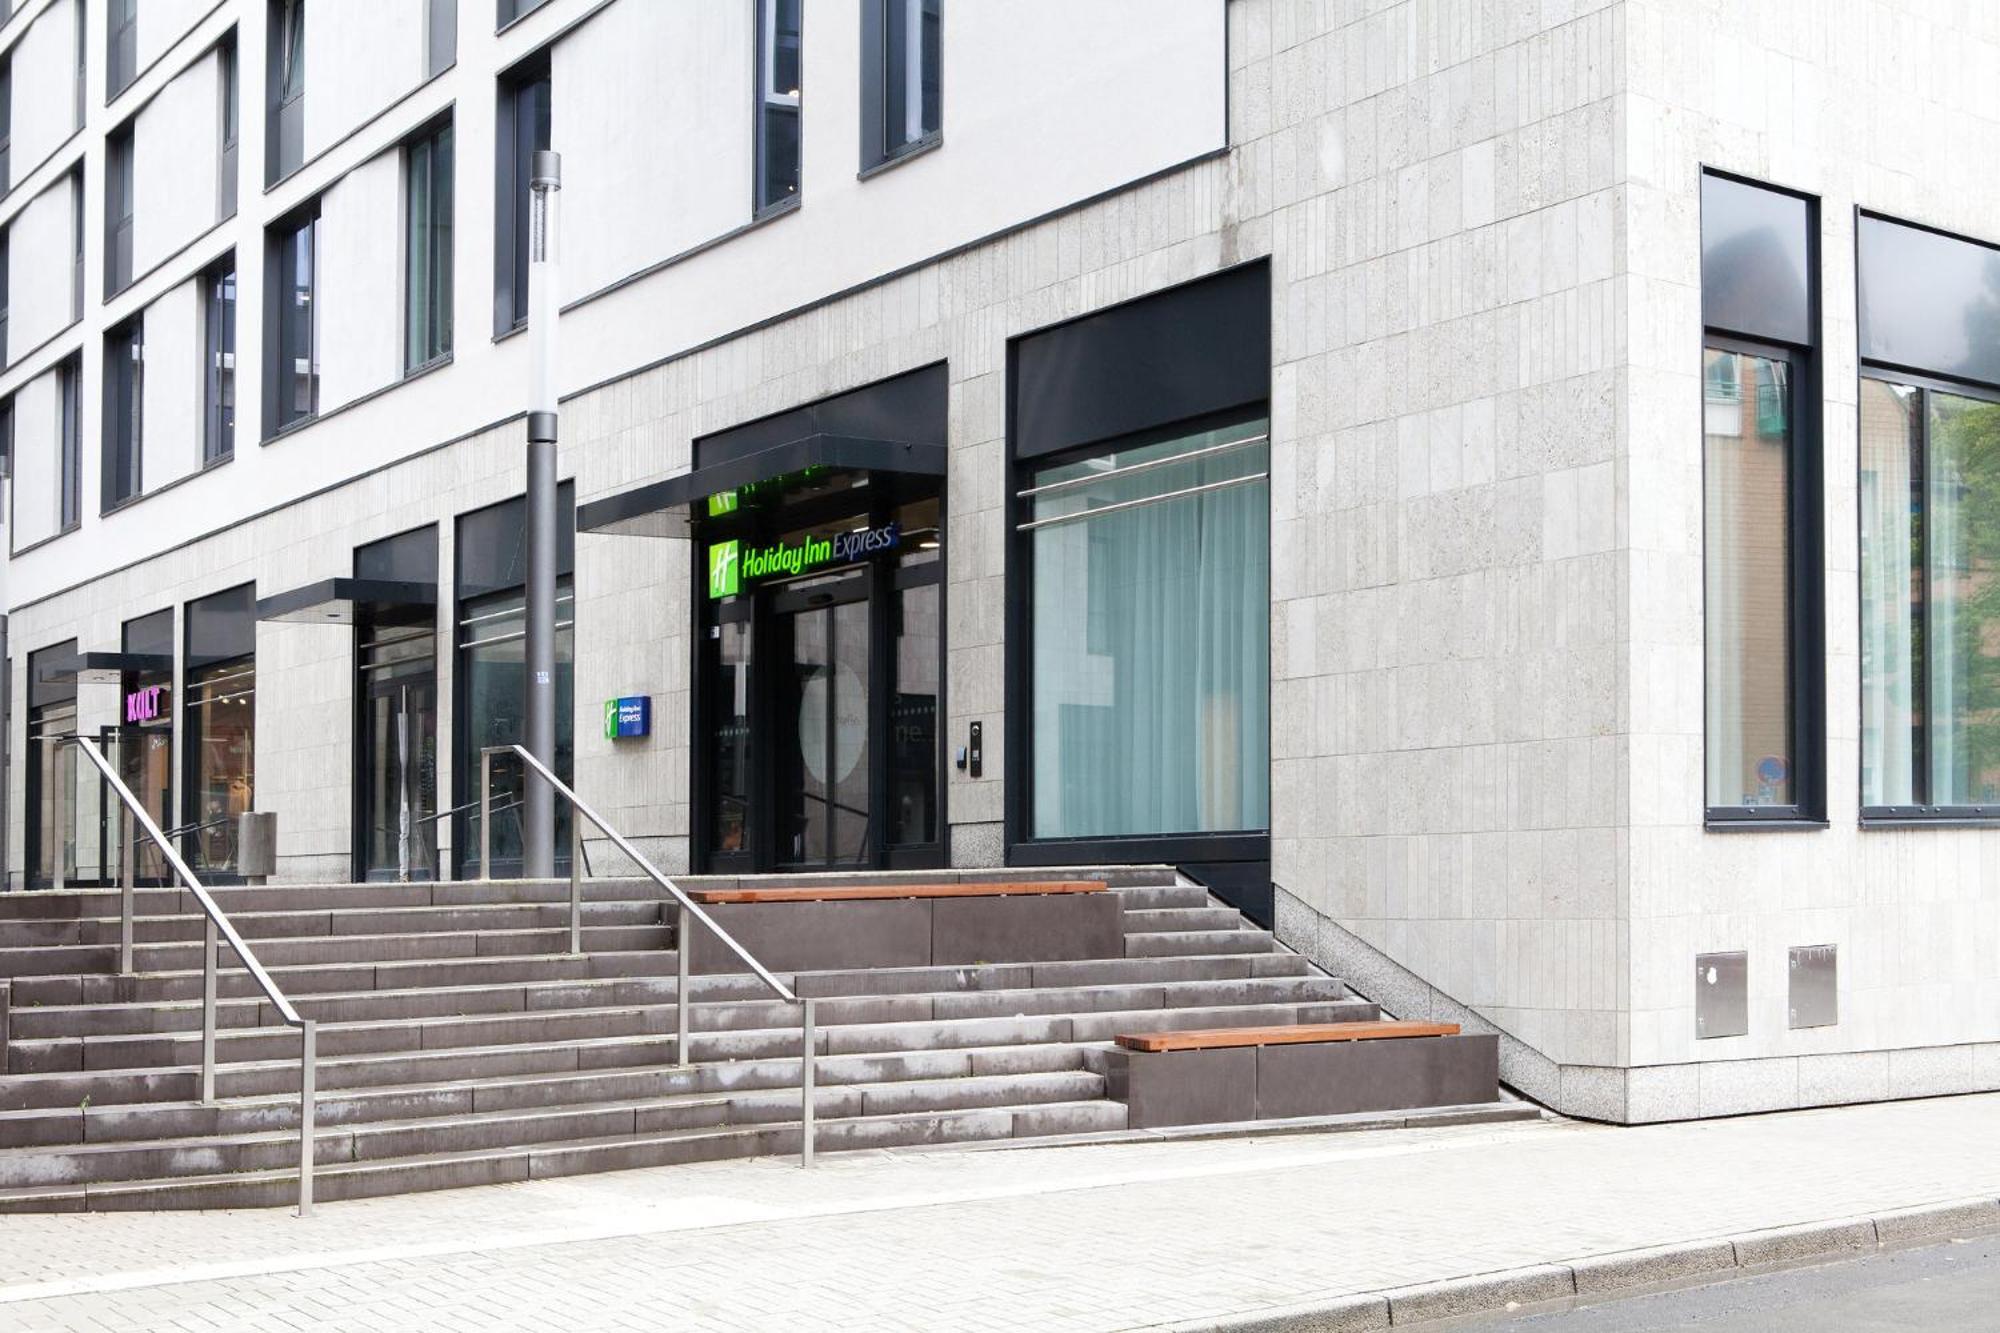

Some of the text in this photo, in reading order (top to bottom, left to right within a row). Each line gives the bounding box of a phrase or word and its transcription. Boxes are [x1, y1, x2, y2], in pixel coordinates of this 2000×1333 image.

[743, 541, 801, 578] Holiday
[804, 535, 830, 565] Inn
[834, 523, 893, 560] Express
[127, 685, 160, 722] KULT
